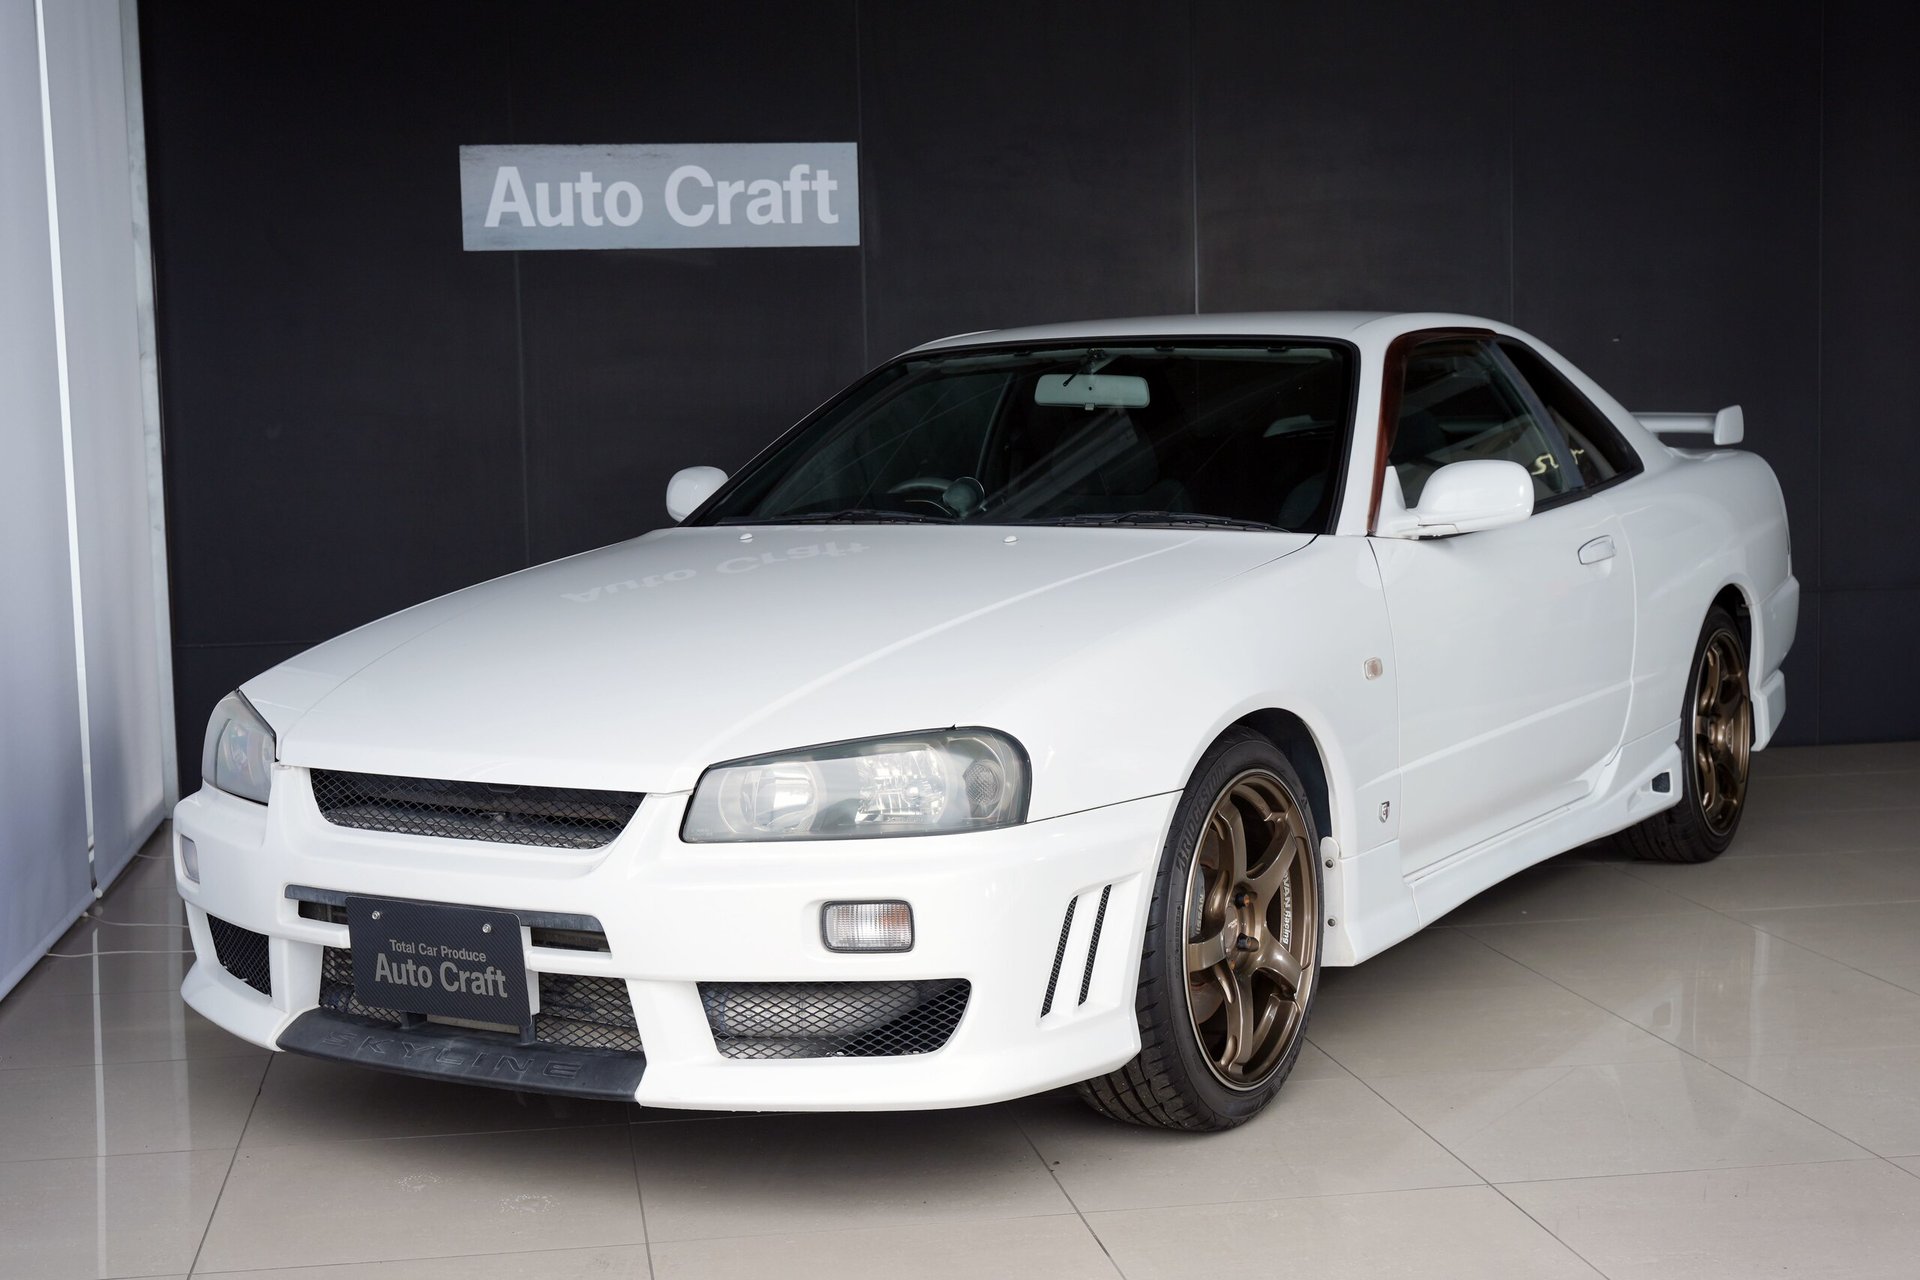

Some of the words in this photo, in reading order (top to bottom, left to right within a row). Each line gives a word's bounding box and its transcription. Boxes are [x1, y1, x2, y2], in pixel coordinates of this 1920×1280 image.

[483, 165, 644, 228] Auto
[664, 164, 840, 227] Craft
[389, 938, 415, 954] Total
[418, 942, 438, 958] Car
[440, 945, 487, 963] Produce
[374, 952, 433, 989] Auto
[439, 961, 508, 998] Craft
[321, 1031, 583, 1080] SKYLINE
